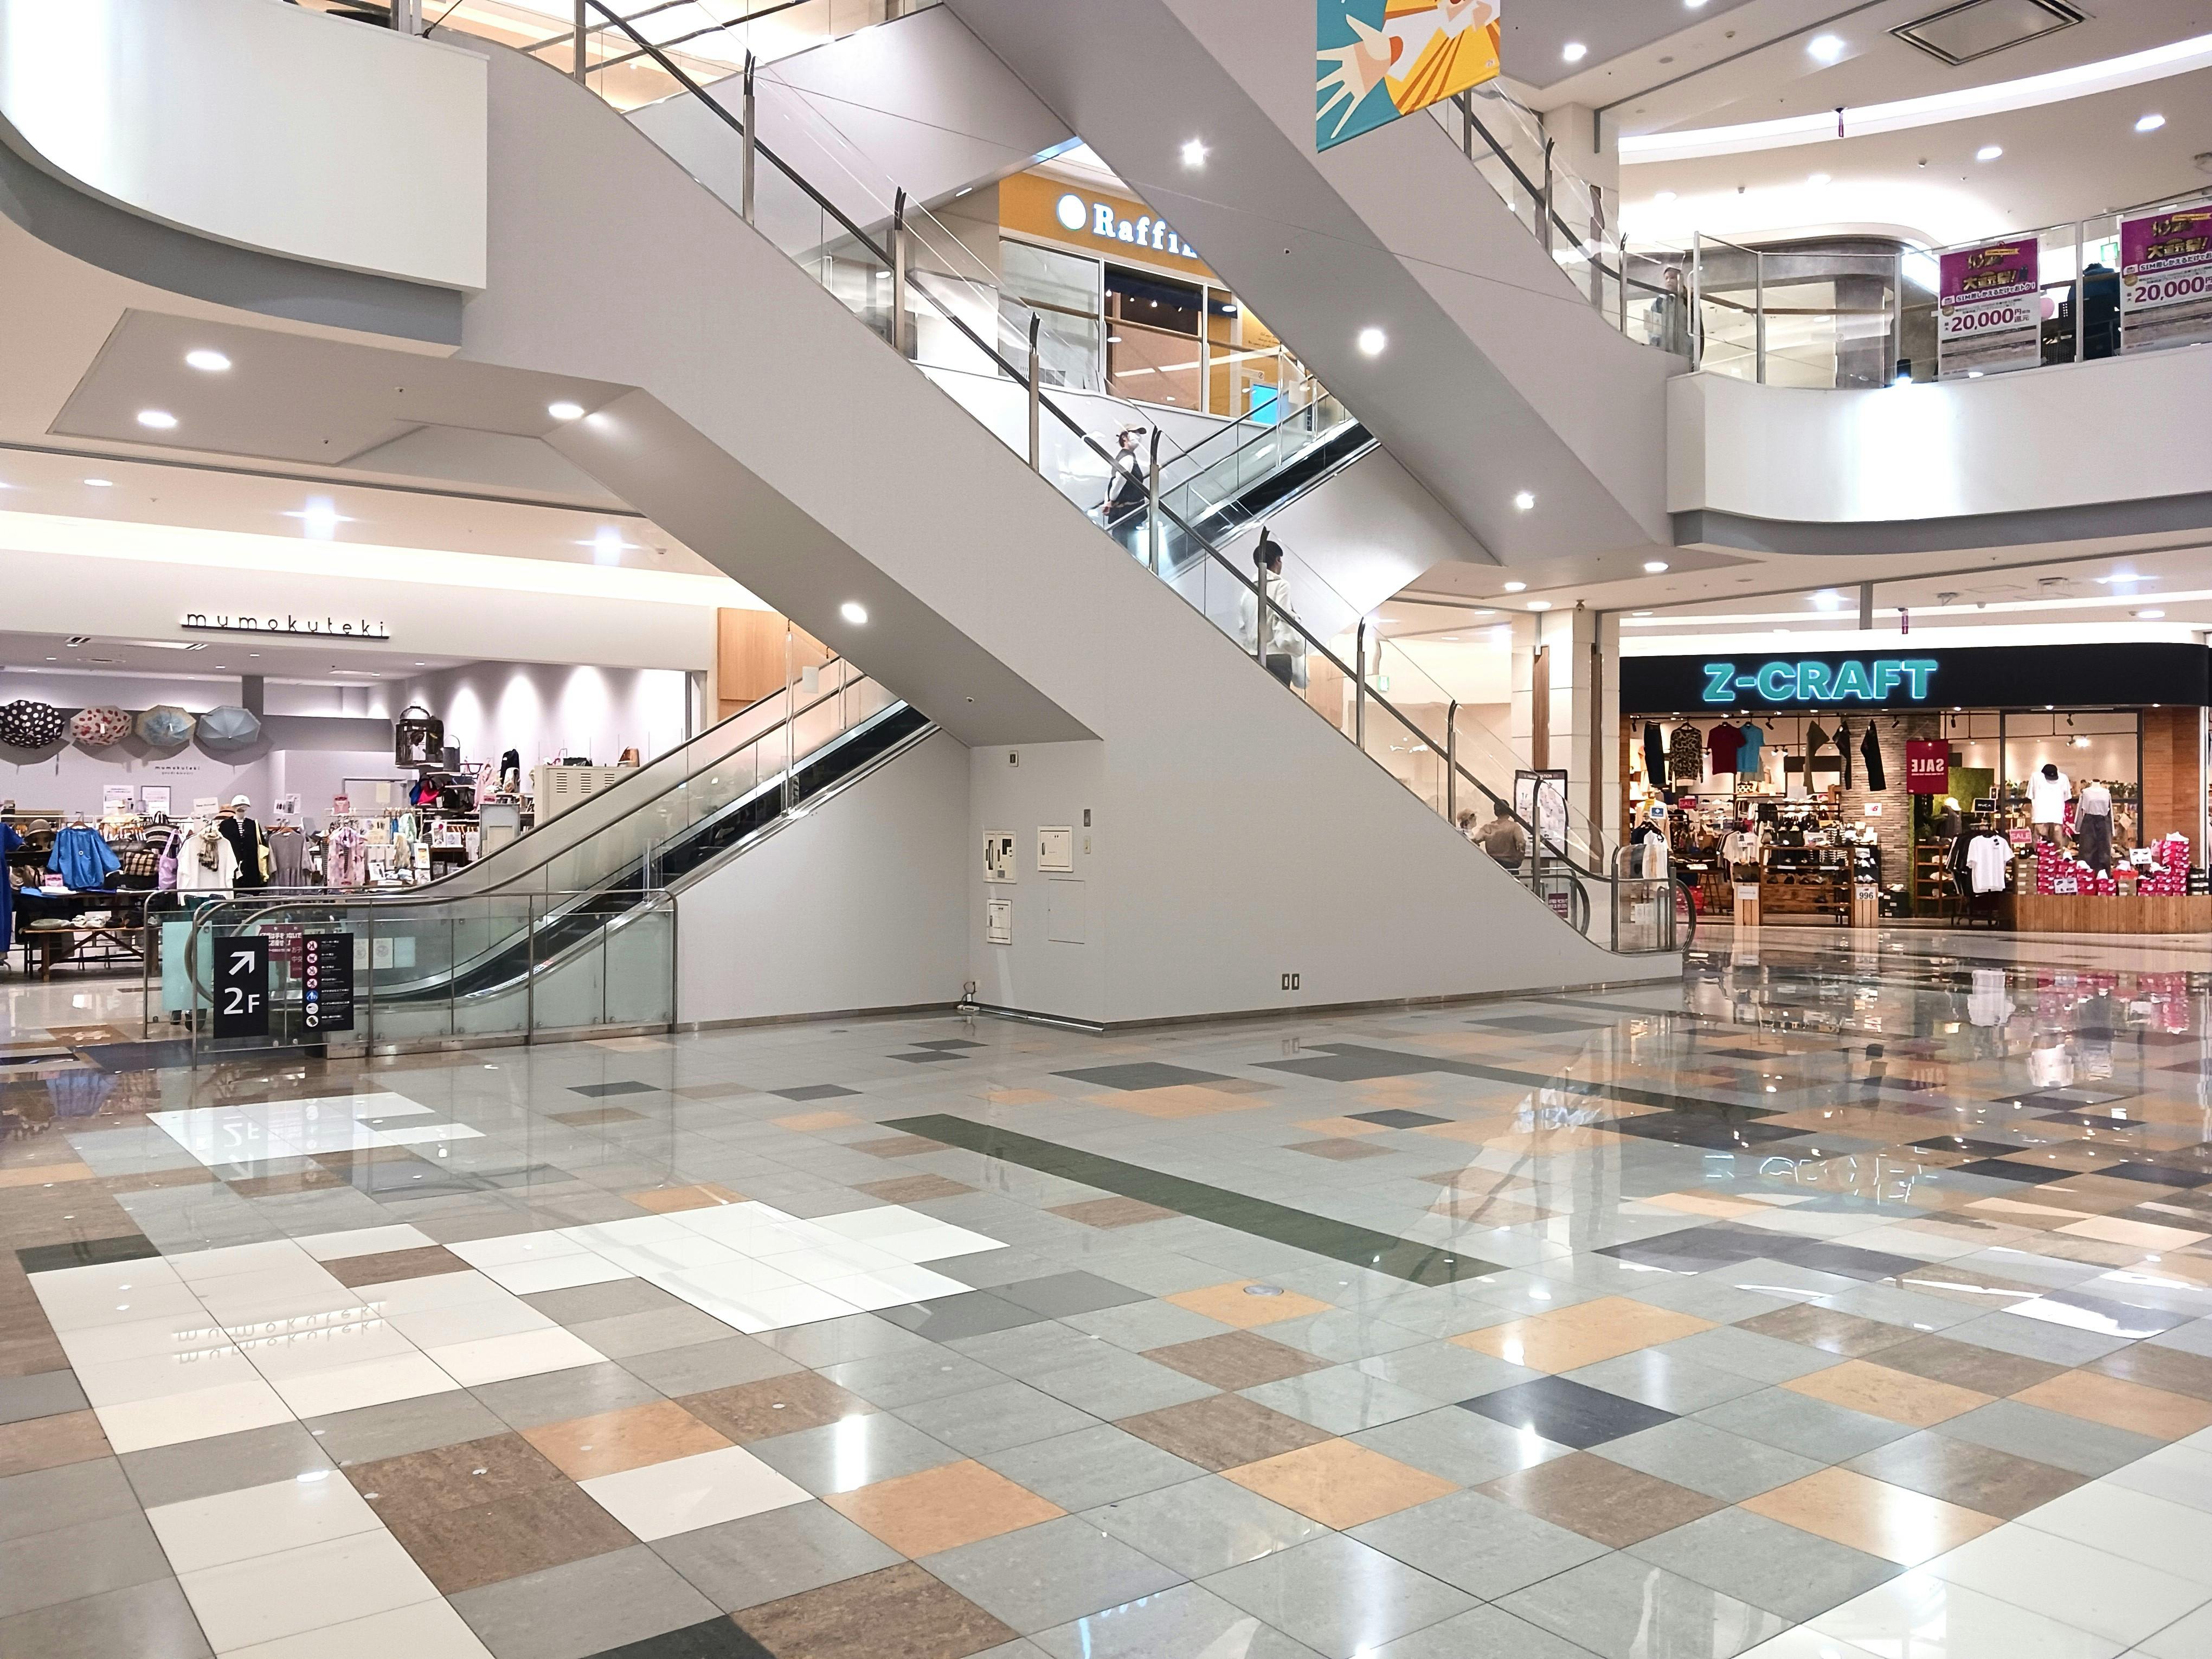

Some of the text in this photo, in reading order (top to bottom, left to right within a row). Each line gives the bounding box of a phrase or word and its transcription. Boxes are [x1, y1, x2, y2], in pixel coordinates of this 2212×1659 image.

[2135, 276, 2204, 303] 20,000
[1951, 308, 2014, 332] 20,000
[187, 613, 384, 637] mumokuteki
[1703, 659, 1938, 702] Z-CRAFT
[223, 987, 260, 1015] 2F
